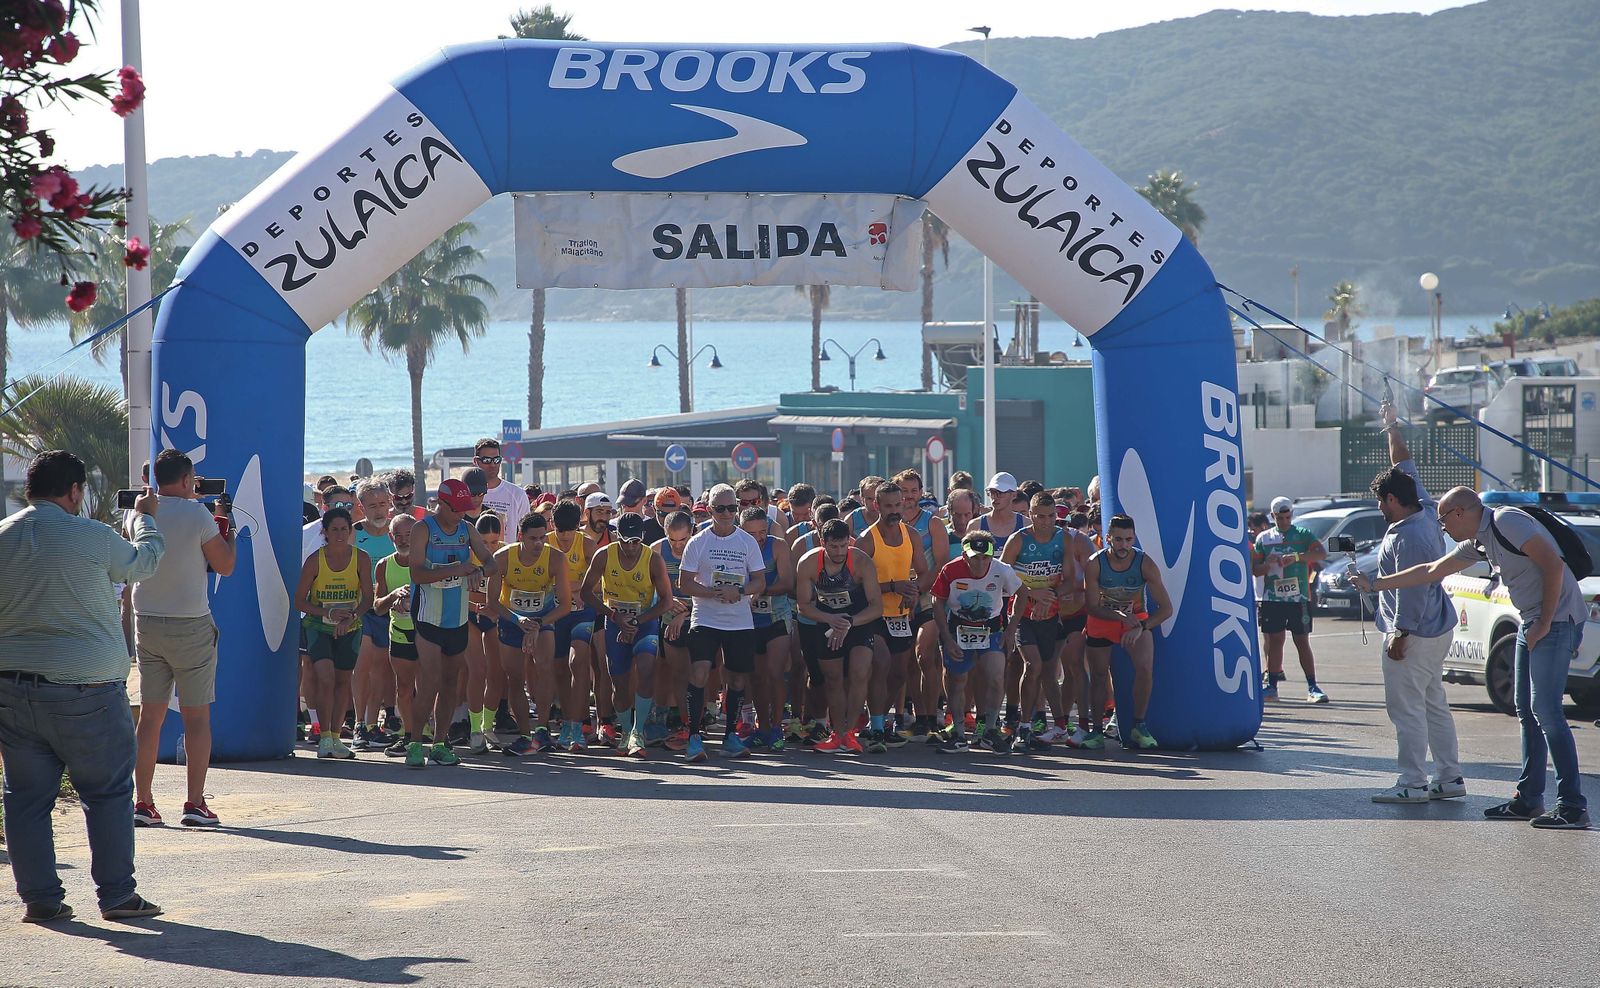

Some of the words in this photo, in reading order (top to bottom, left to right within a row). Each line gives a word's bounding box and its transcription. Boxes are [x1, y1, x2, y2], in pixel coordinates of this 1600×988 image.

[548, 47, 872, 94] BROOKS
[241, 112, 424, 258] DEPORTES
[995, 118, 1165, 265] DEPORTES
[263, 136, 464, 292] ZULAICA
[966, 141, 1145, 306] ZULAICA
[561, 247, 604, 257] Malacitano
[651, 222, 848, 260] SALIDA
[503, 426, 521, 435] TAXI
[1201, 380, 1255, 701] BROOKS
[1277, 583, 1297, 593] 402
[513, 598, 541, 608] 315
[888, 621, 907, 631] 339
[960, 634, 987, 643] 327
[1466, 641, 1486, 660] CIVIL
